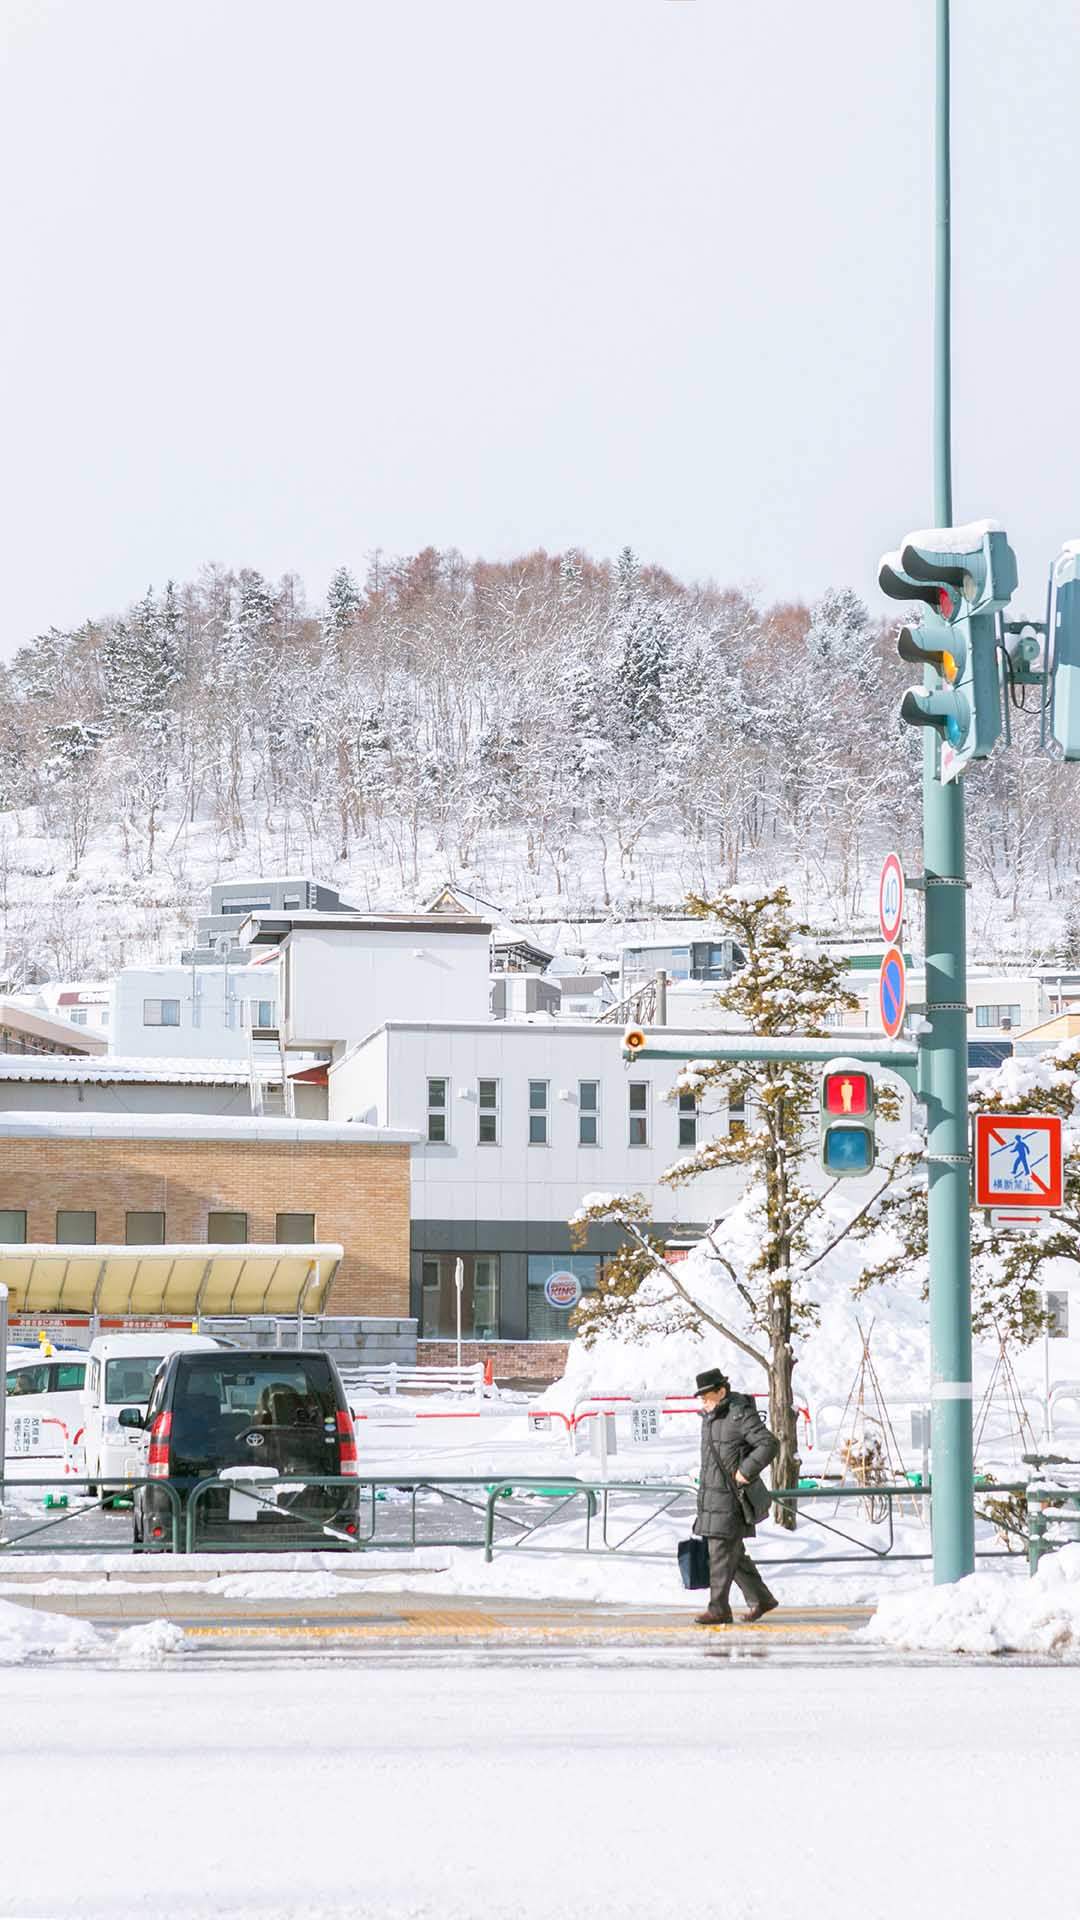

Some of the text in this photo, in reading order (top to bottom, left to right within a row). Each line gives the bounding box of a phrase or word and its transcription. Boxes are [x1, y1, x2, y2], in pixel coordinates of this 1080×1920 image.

[885, 879, 898, 914] 40
[993, 1178, 1033, 1192] 横断禁止
[550, 1287, 577, 1297] KING
